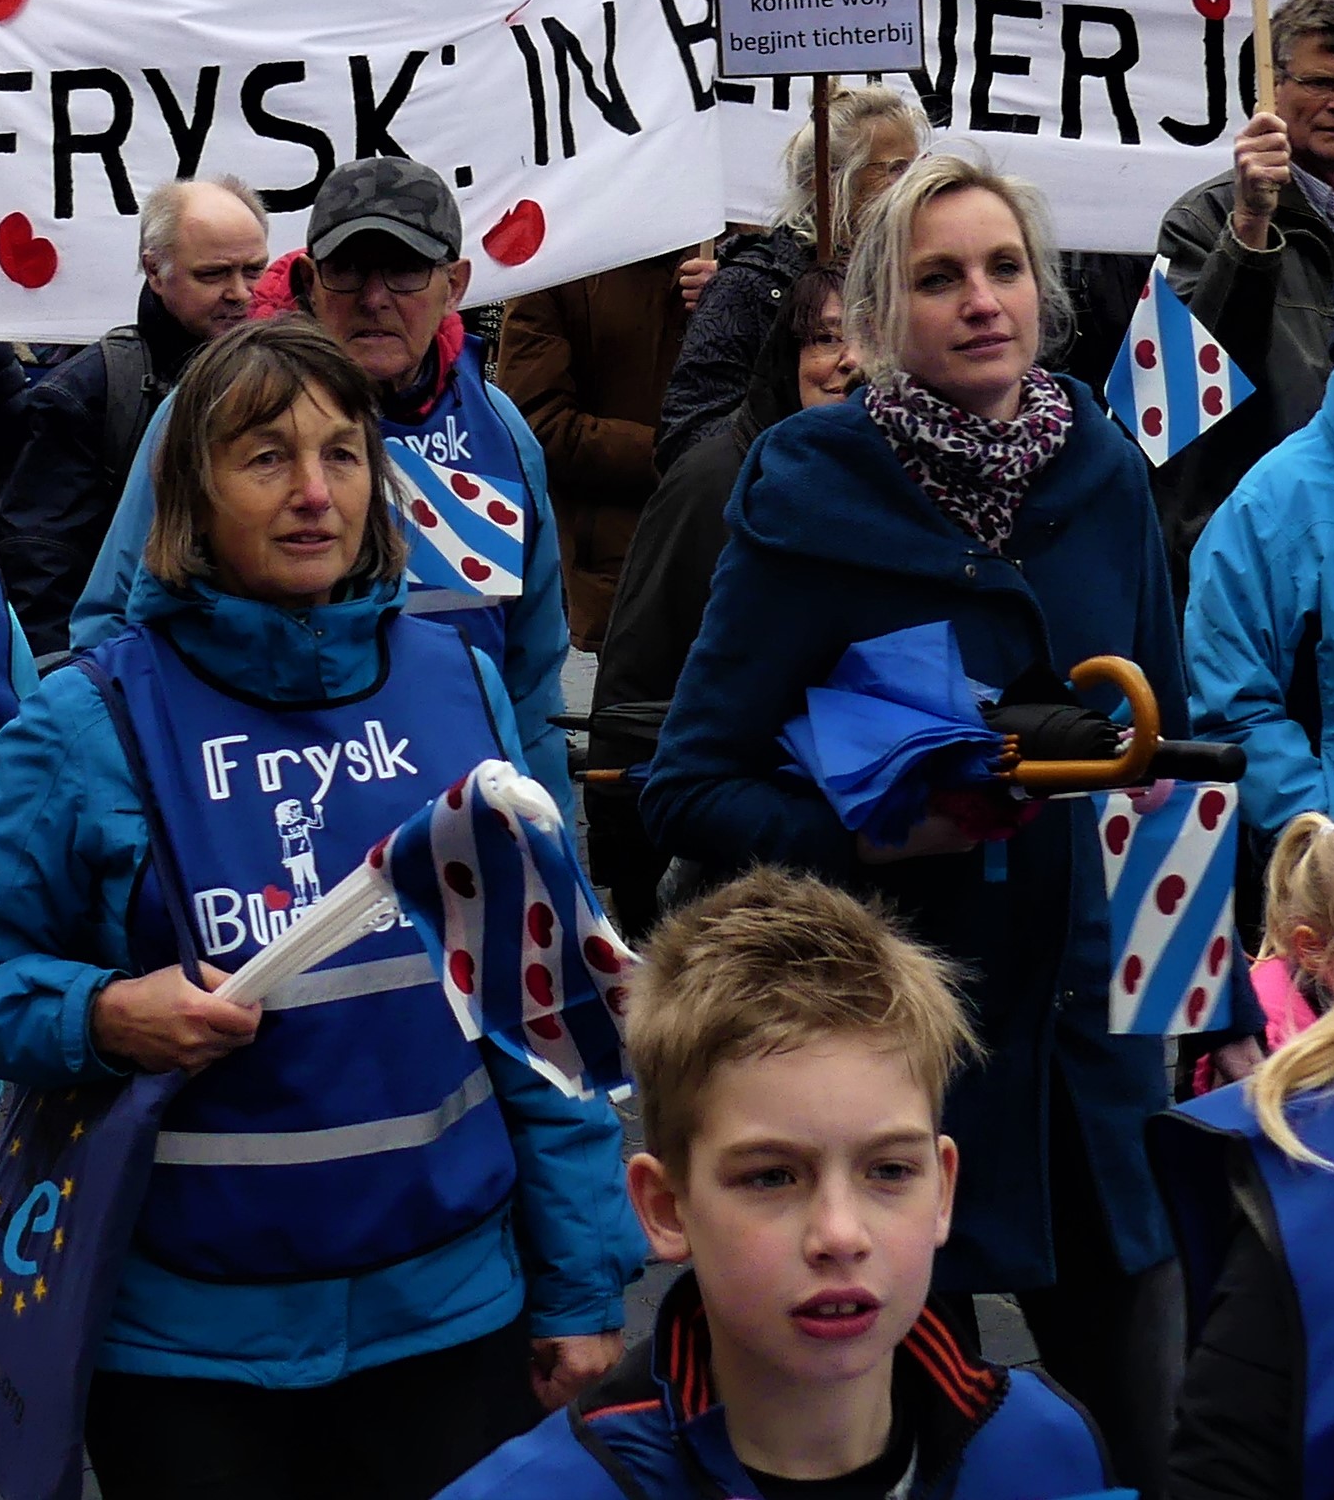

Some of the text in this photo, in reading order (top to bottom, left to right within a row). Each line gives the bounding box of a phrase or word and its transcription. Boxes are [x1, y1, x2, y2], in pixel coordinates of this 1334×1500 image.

[729, 22, 914, 55] begjint tichterbij
[509, 0, 642, 167] IN
[202, 720, 418, 804] Frysk
